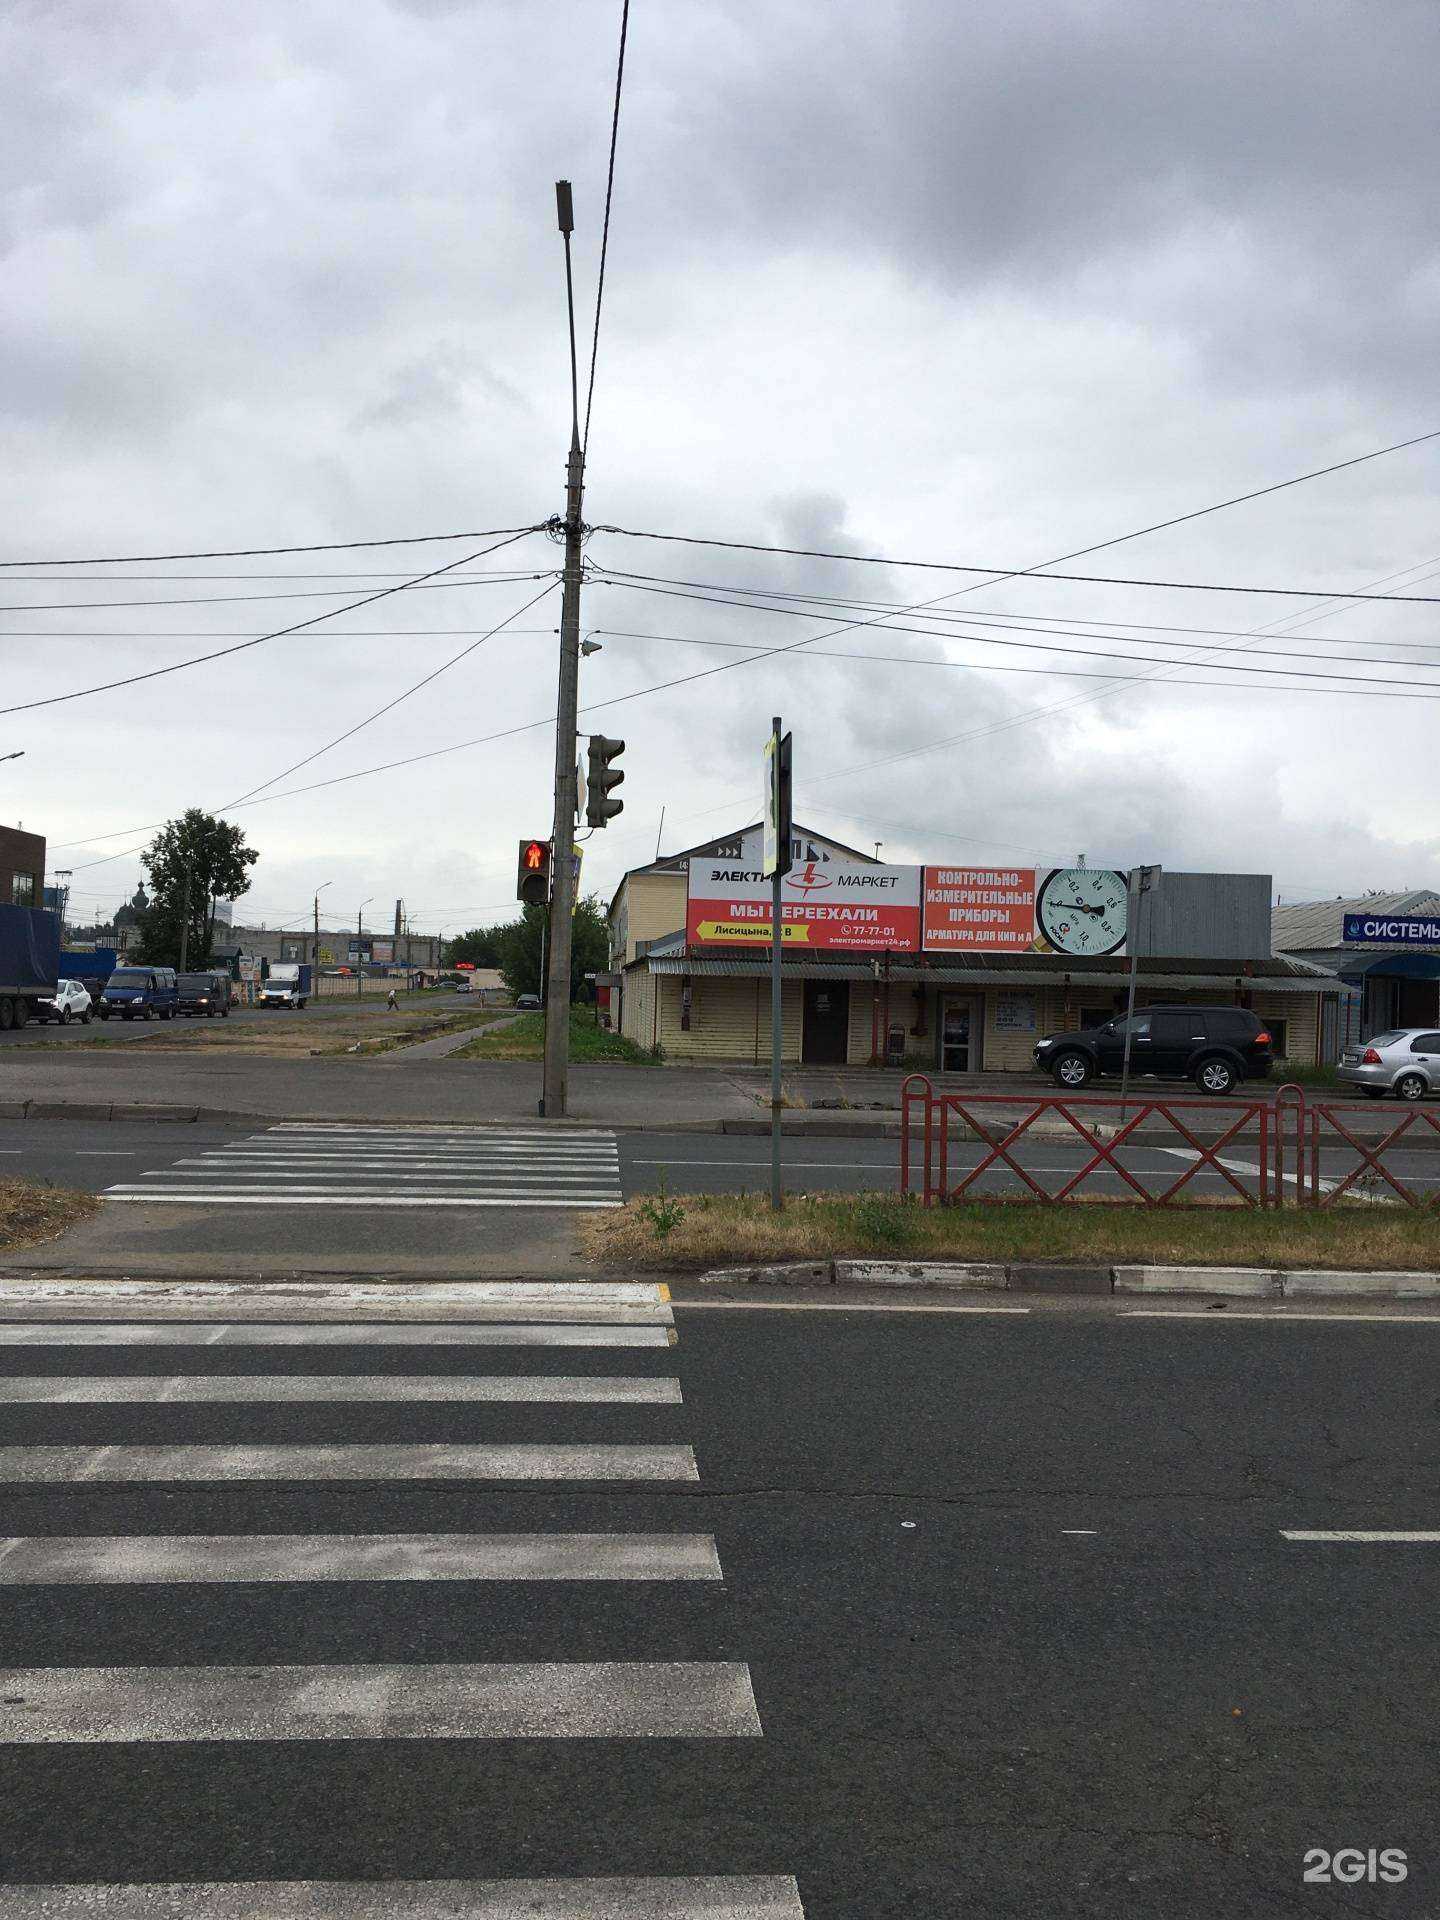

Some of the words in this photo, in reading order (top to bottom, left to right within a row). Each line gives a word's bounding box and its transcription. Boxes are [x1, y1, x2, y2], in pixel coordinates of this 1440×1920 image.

[837, 875, 899, 888] МАРКЕТ
[937, 871, 1023, 886] КОНТРОЛЬНО-
[926, 889, 1033, 905] ИЗМЕРИТЕЛЬНЫЕ
[730, 904, 764, 918] МЫ
[949, 908, 1010, 923] ПРИБОРЫ
[714, 925, 772, 937] Лисицына,
[852, 926, 896, 936] 77-77-01
[926, 929, 974, 941] АРМАТУРА
[975, 930, 996, 942] ДЛЯ
